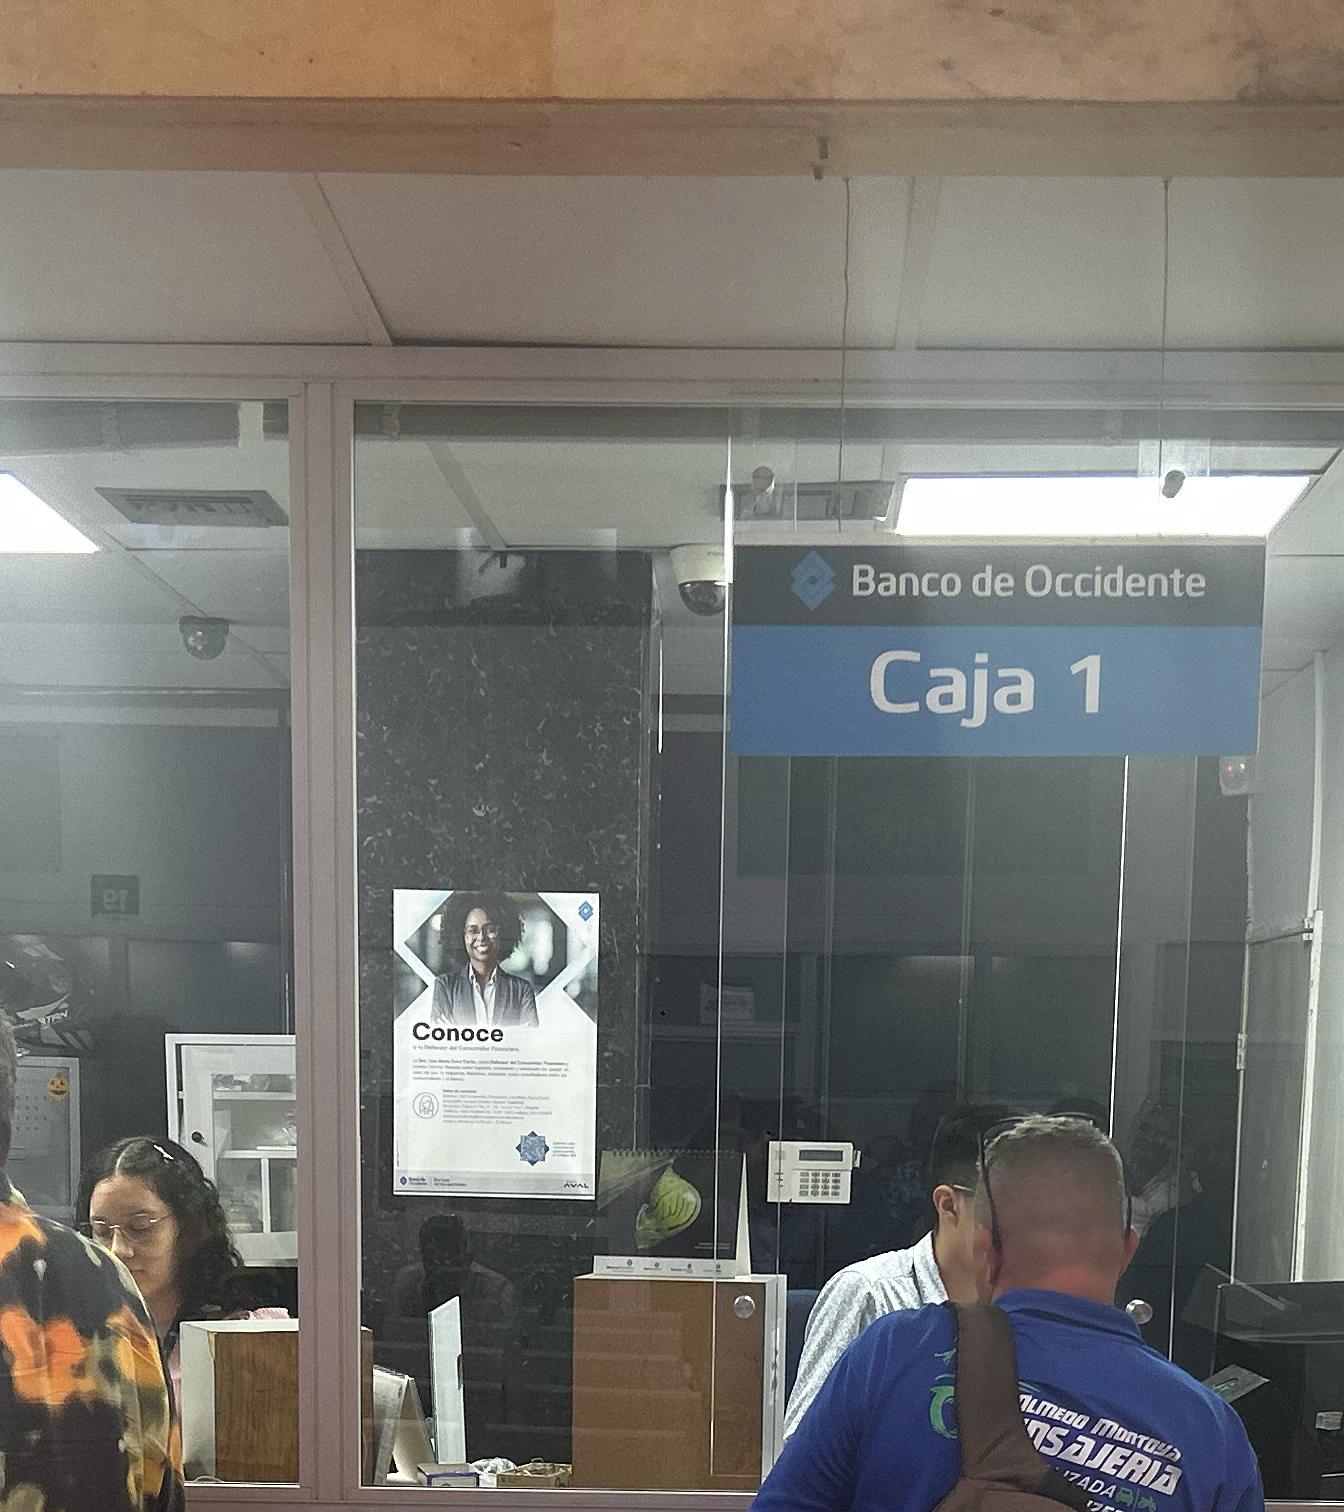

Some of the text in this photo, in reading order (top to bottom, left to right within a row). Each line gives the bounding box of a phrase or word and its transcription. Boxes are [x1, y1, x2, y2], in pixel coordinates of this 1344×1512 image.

[852, 564, 1206, 598] Banco de Occidente
[870, 650, 1102, 728] Caja 1
[413, 1022, 504, 1042] Conoce
[1024, 1418, 1183, 1495] NSAJERIA
